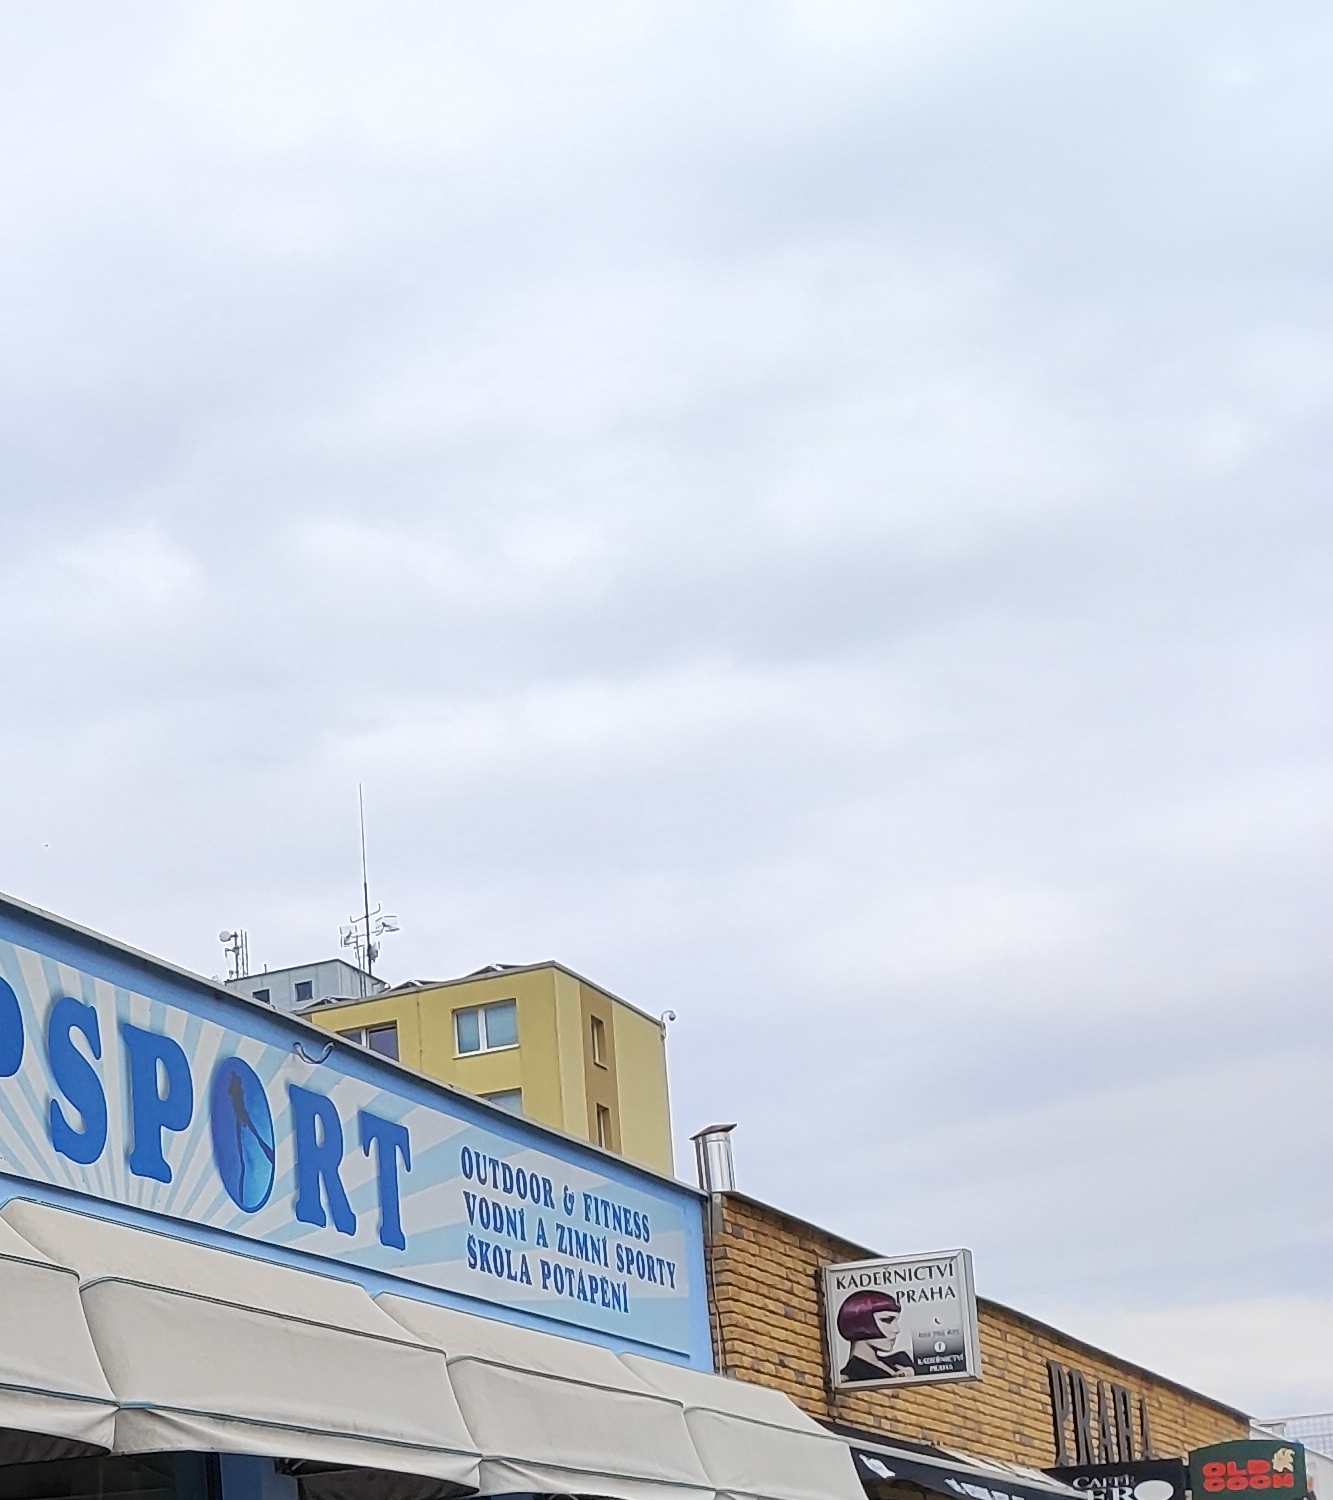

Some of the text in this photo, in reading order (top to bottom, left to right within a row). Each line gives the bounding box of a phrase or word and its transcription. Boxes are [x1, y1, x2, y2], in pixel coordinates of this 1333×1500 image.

[461, 1146, 651, 1243] OUTDOOR & FITNESS
[463, 1190, 677, 1290] VODNÍ A ZIMNÍ SPORTY
[467, 1232, 532, 1286] ŠKOLA
[836, 1261, 954, 1290] KADEŘNICTVÍ
[896, 1284, 956, 1304] PRAHA
[1047, 1360, 1156, 1466] PRAHA
